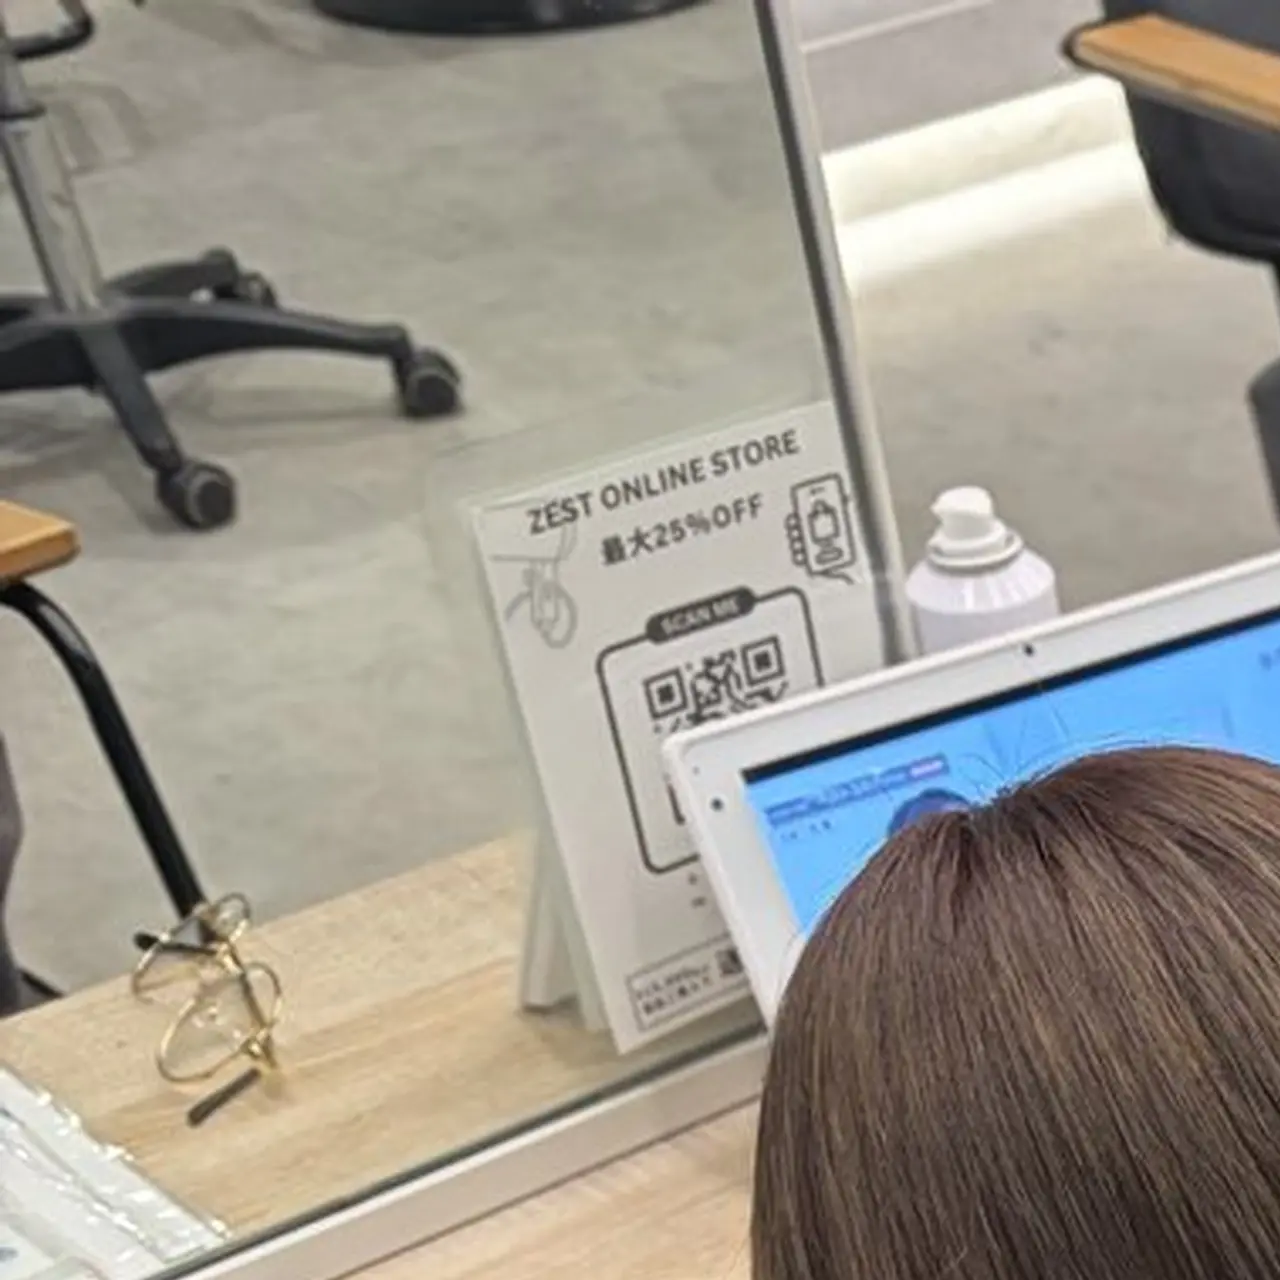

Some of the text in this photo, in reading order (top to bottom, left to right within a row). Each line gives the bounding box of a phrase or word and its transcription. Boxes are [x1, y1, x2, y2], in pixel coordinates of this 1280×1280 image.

[526, 429, 799, 535] ZEST ONLINE STORE
[601, 493, 764, 566] 最大25%OFF
